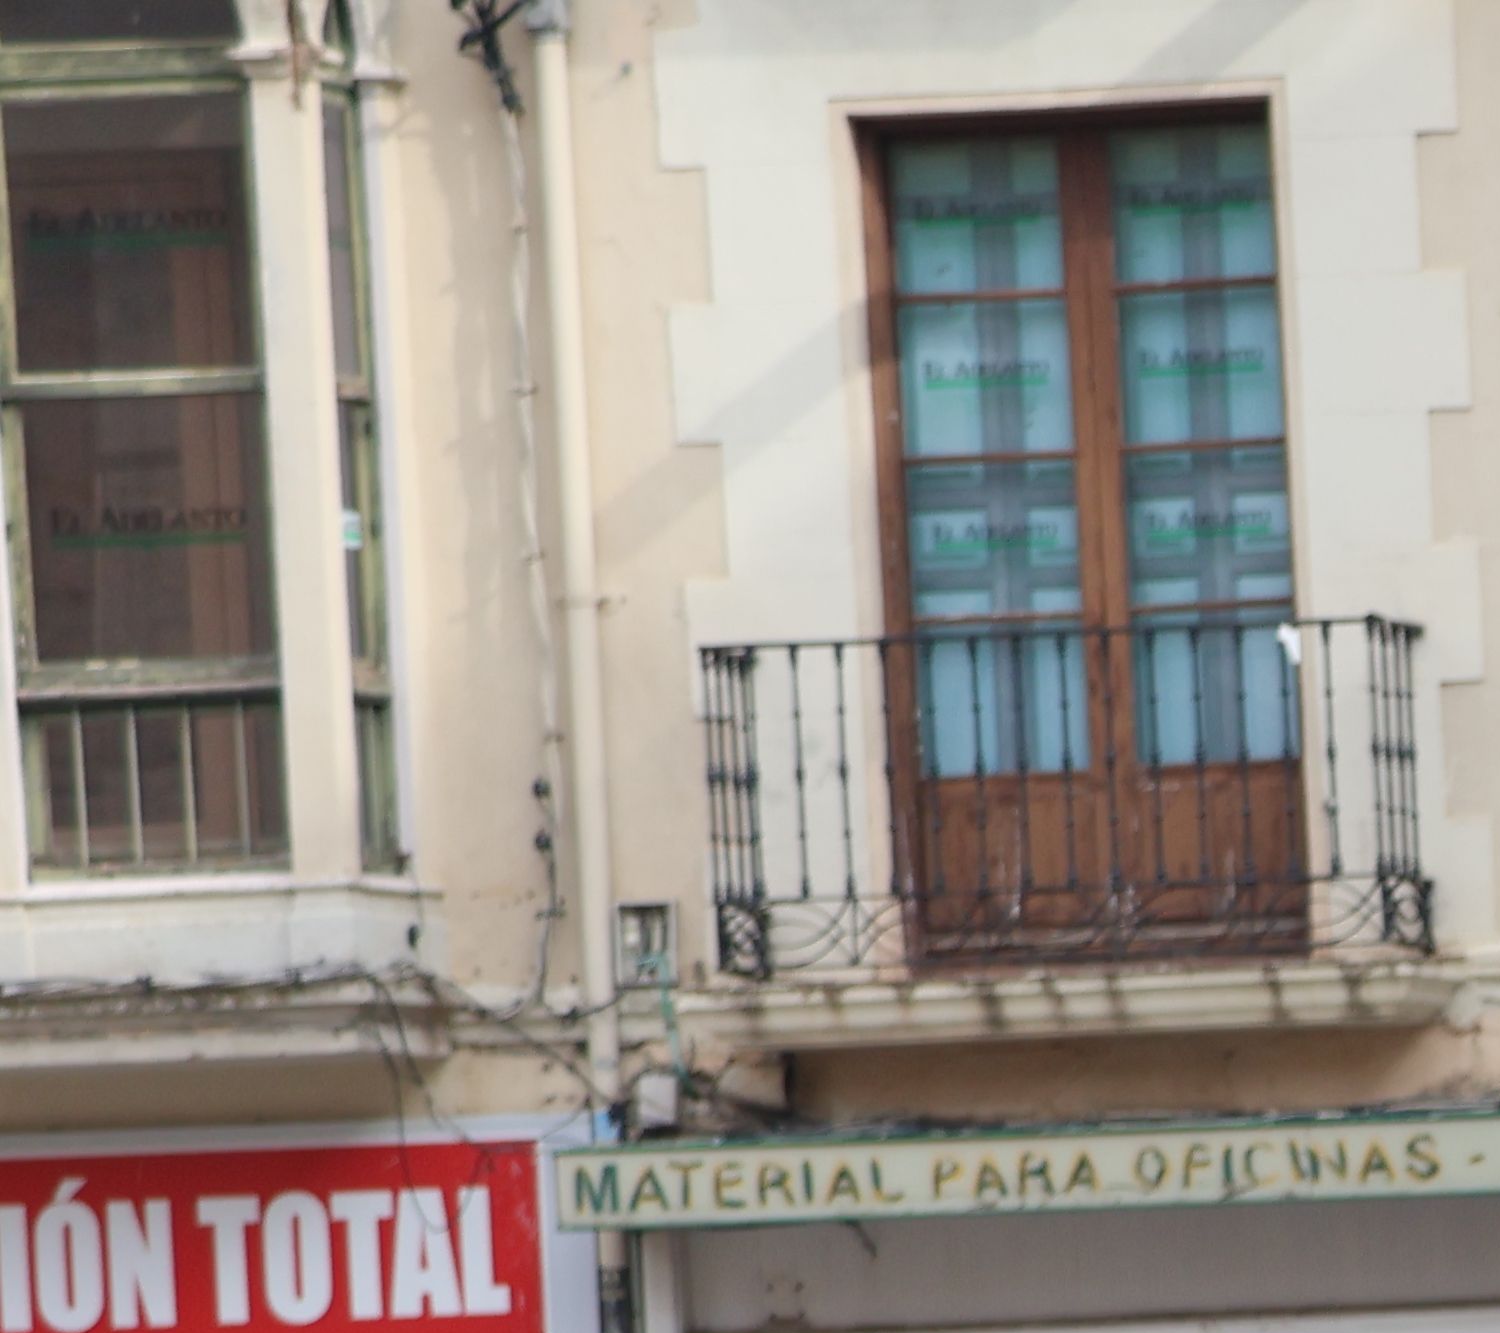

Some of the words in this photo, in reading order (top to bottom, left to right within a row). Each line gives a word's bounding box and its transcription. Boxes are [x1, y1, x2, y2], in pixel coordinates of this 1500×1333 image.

[574, 1158, 903, 1215] MATERIAL
[932, 1149, 1098, 1199] PARA
[1134, 1133, 1441, 1189] OFICINAS
[195, 1185, 512, 1328] TOTAL
